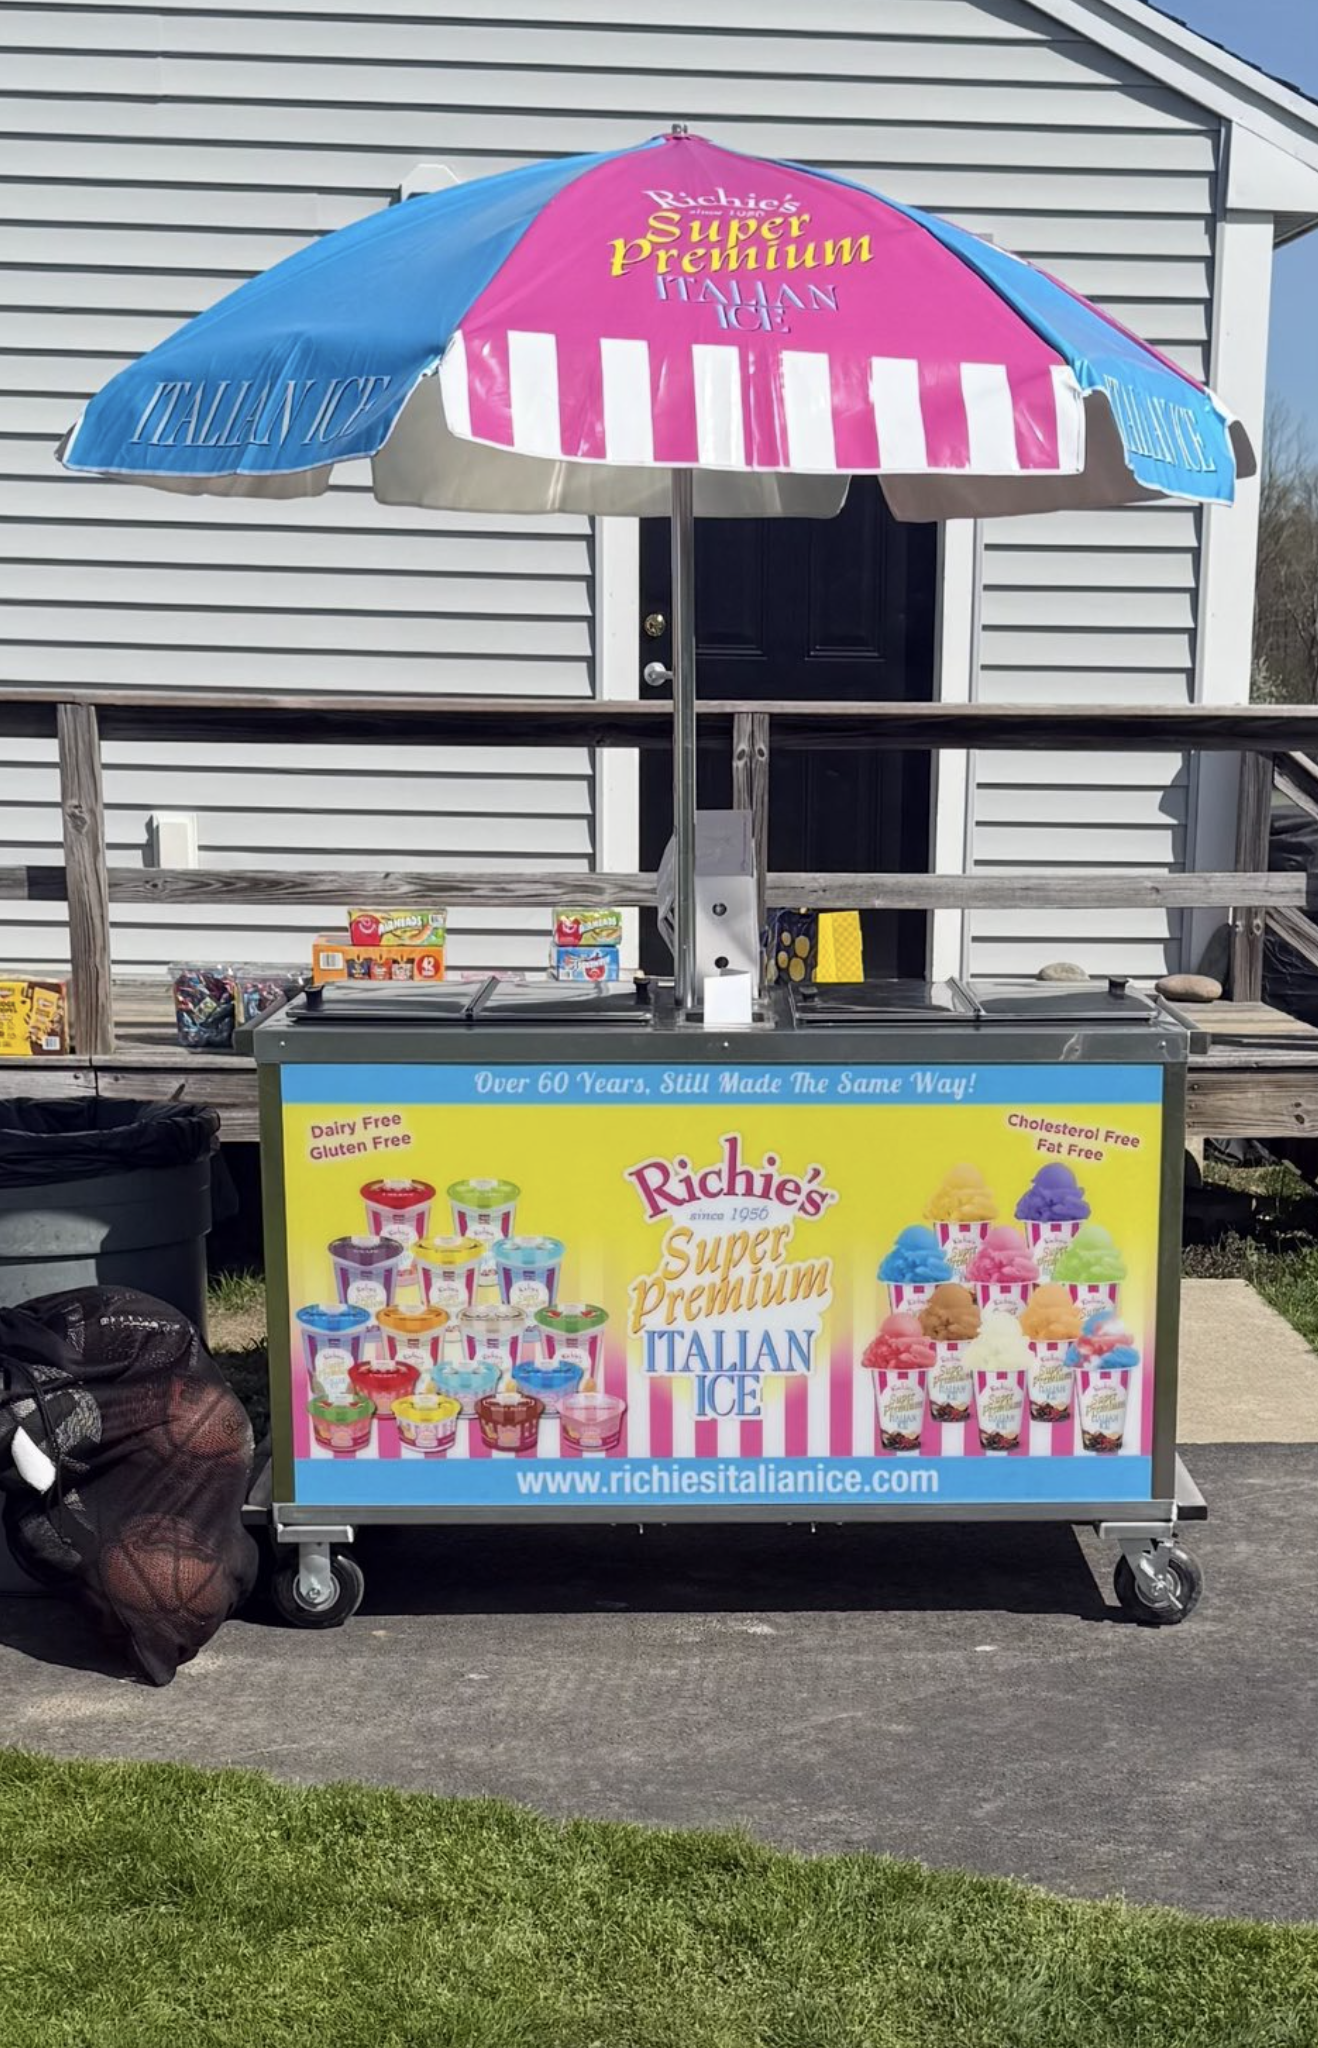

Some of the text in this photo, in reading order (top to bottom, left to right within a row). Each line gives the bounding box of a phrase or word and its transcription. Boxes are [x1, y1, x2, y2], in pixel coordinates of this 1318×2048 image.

[642, 187, 801, 214] Richie's
[647, 211, 811, 251] Super
[606, 235, 874, 277] Premium
[654, 275, 839, 312] ITALIAN
[716, 304, 791, 333] ICE
[129, 379, 310, 448] ITALIAN
[474, 1070, 977, 1100] Over 60 Years, Still Made The Same Way!
[311, 1114, 402, 1139] Dairy Free
[1007, 1113, 1140, 1148] Cholesterol Free
[310, 1133, 411, 1160] Gluten Free
[1037, 1138, 1104, 1161] Fat Free
[628, 1136, 829, 1219] Richie's
[689, 1206, 769, 1221] since 1956
[663, 1223, 790, 1281] Super
[632, 1260, 830, 1333] Premium
[645, 1329, 815, 1372] ITALIAN
[695, 1374, 762, 1417] ICE
[516, 1463, 939, 1495] www.richiesitalianice.com
